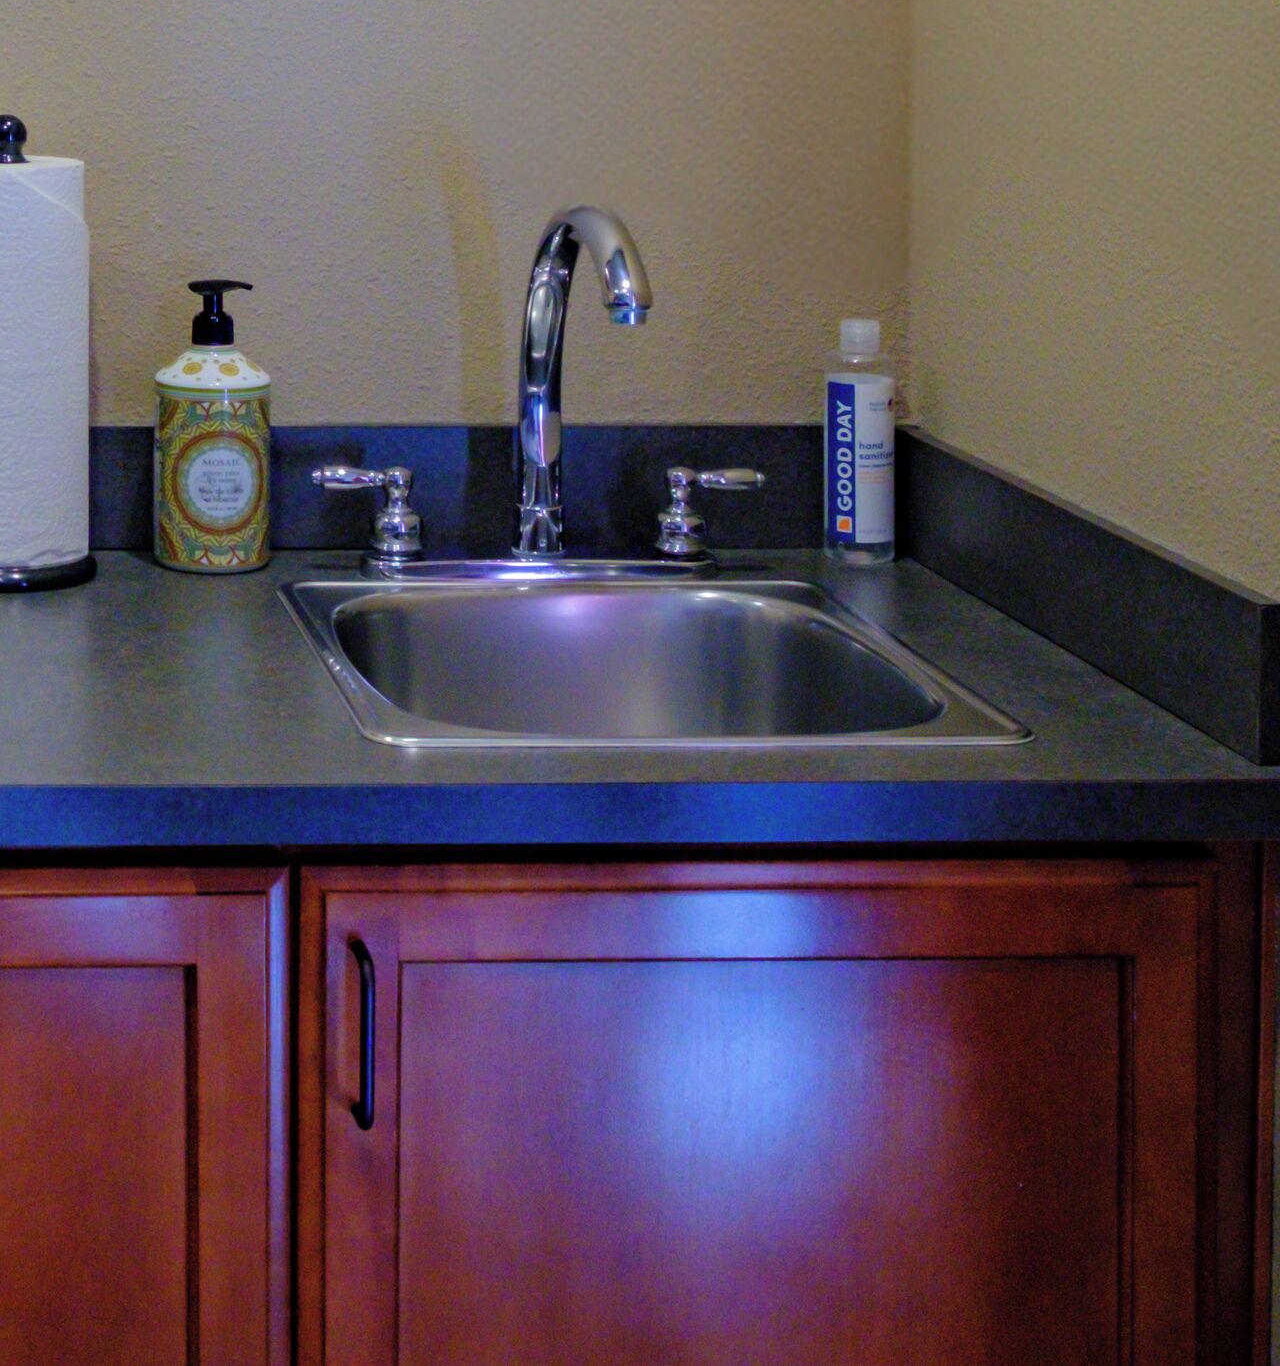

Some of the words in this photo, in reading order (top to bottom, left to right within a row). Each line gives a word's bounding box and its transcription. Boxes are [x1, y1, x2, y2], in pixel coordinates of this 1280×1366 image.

[836, 399, 853, 443] DAY
[858, 441, 884, 450] hand
[836, 446, 854, 512] GOOD
